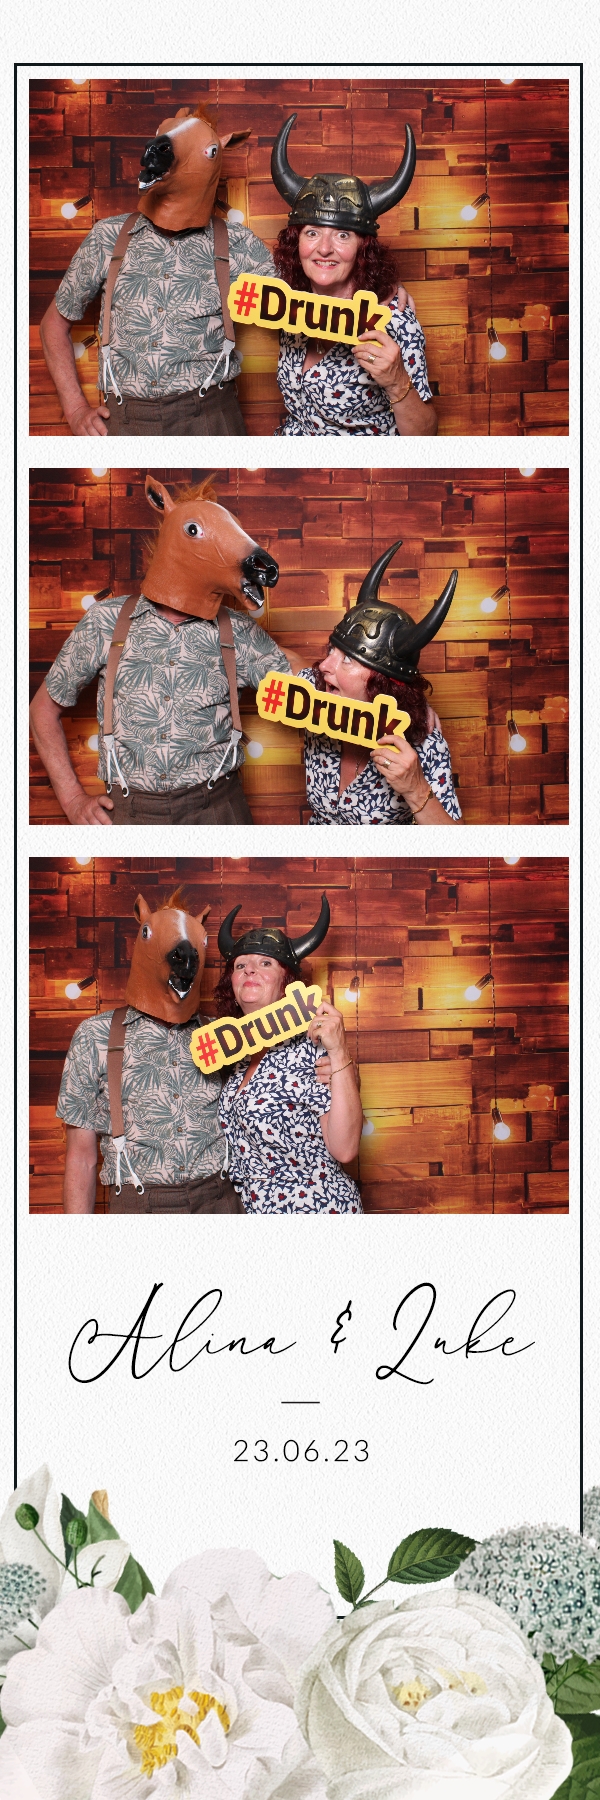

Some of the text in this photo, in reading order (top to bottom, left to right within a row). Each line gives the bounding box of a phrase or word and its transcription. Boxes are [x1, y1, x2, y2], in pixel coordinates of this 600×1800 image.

[233, 280, 383, 338] #Drunk
[261, 678, 403, 742] #Drunk
[196, 988, 319, 1068] #Drunk
